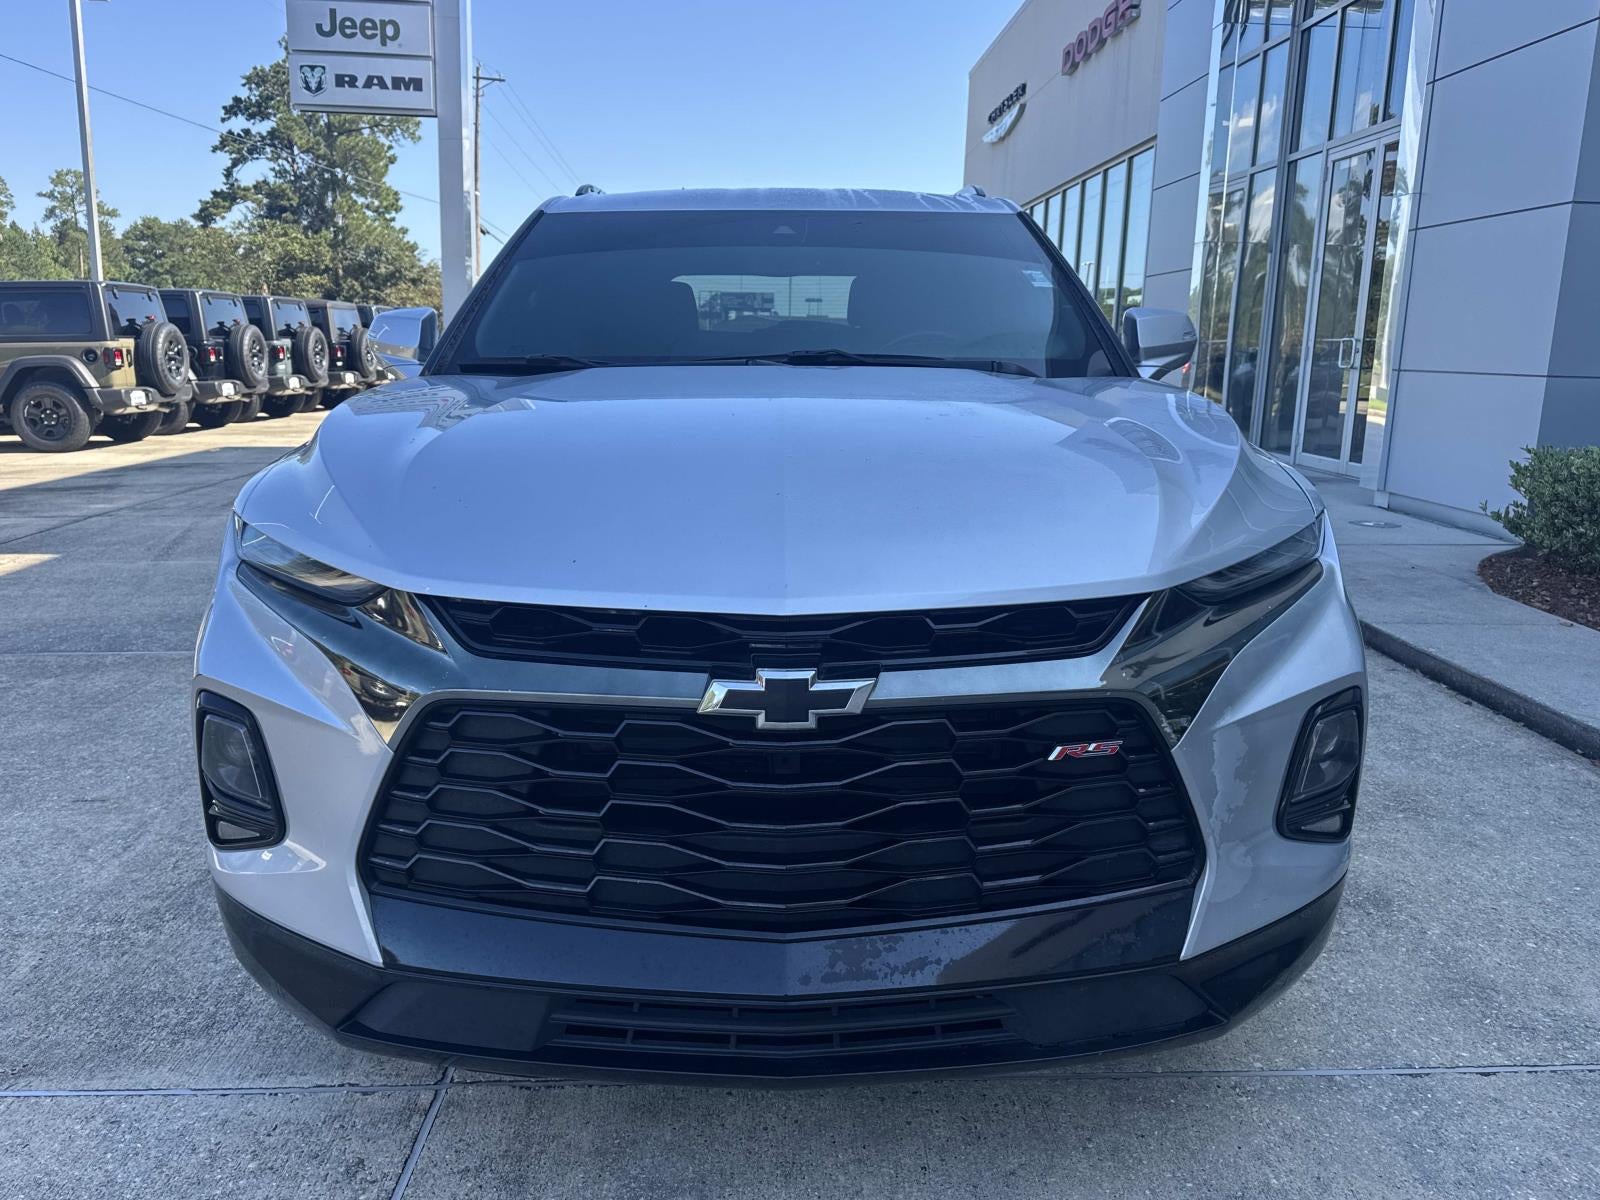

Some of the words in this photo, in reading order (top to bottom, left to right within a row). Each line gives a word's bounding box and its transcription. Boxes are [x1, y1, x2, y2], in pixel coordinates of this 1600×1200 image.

[315, 8, 401, 47] Jeep
[334, 73, 424, 92] RAM
[1047, 740, 1123, 761] RS
